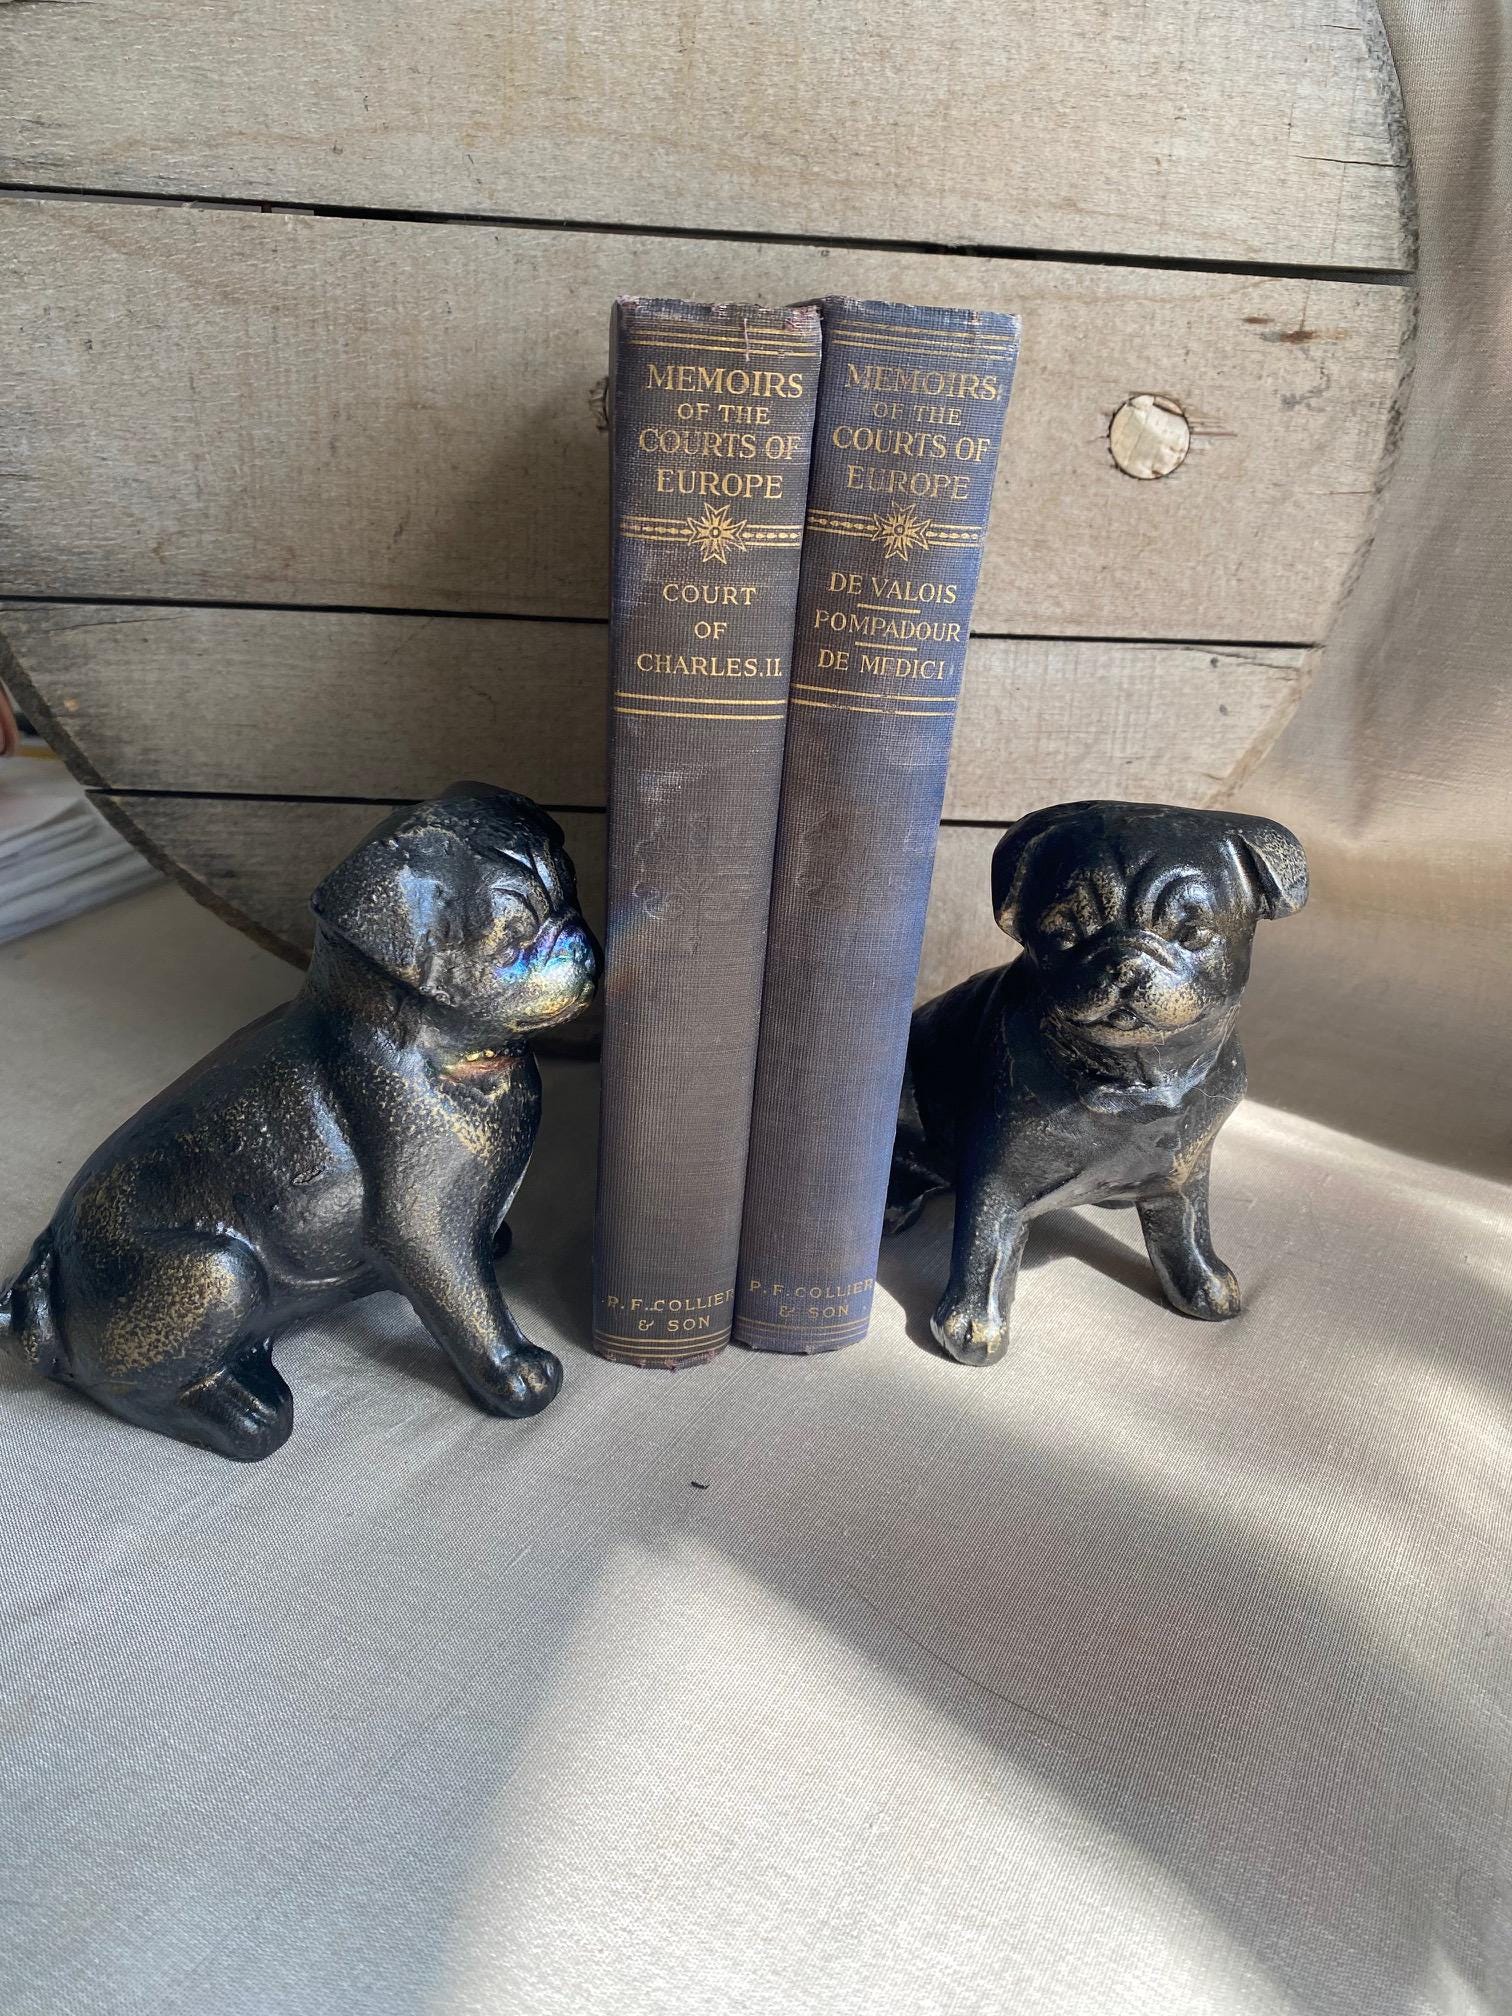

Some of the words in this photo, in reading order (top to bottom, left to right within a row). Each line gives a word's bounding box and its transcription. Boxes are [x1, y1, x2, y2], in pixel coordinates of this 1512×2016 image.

[646, 364, 804, 399] MEMOIRS
[845, 363, 998, 401] MEMOIRS
[677, 402, 710, 421] OF
[718, 404, 771, 425] THE
[873, 401, 904, 420] OF
[914, 405, 963, 426] THE
[639, 428, 757, 459] COURTS
[765, 435, 802, 460] OF
[832, 425, 948, 459] COURTS
[955, 436, 991, 462] OF
[656, 468, 783, 499] EUROPE
[846, 464, 971, 500] EUROPE
[662, 583, 757, 606] COURT
[828, 571, 863, 595] DE
[871, 577, 958, 604] VALOIS
[694, 621, 728, 640] OF
[814, 608, 961, 643] POMPADOUR
[817, 648, 850, 671] DE
[860, 654, 946, 681] MEDICI
[638, 1319, 655, 1332] &
[667, 1315, 710, 1332] SON
[807, 1304, 849, 1319] SON
